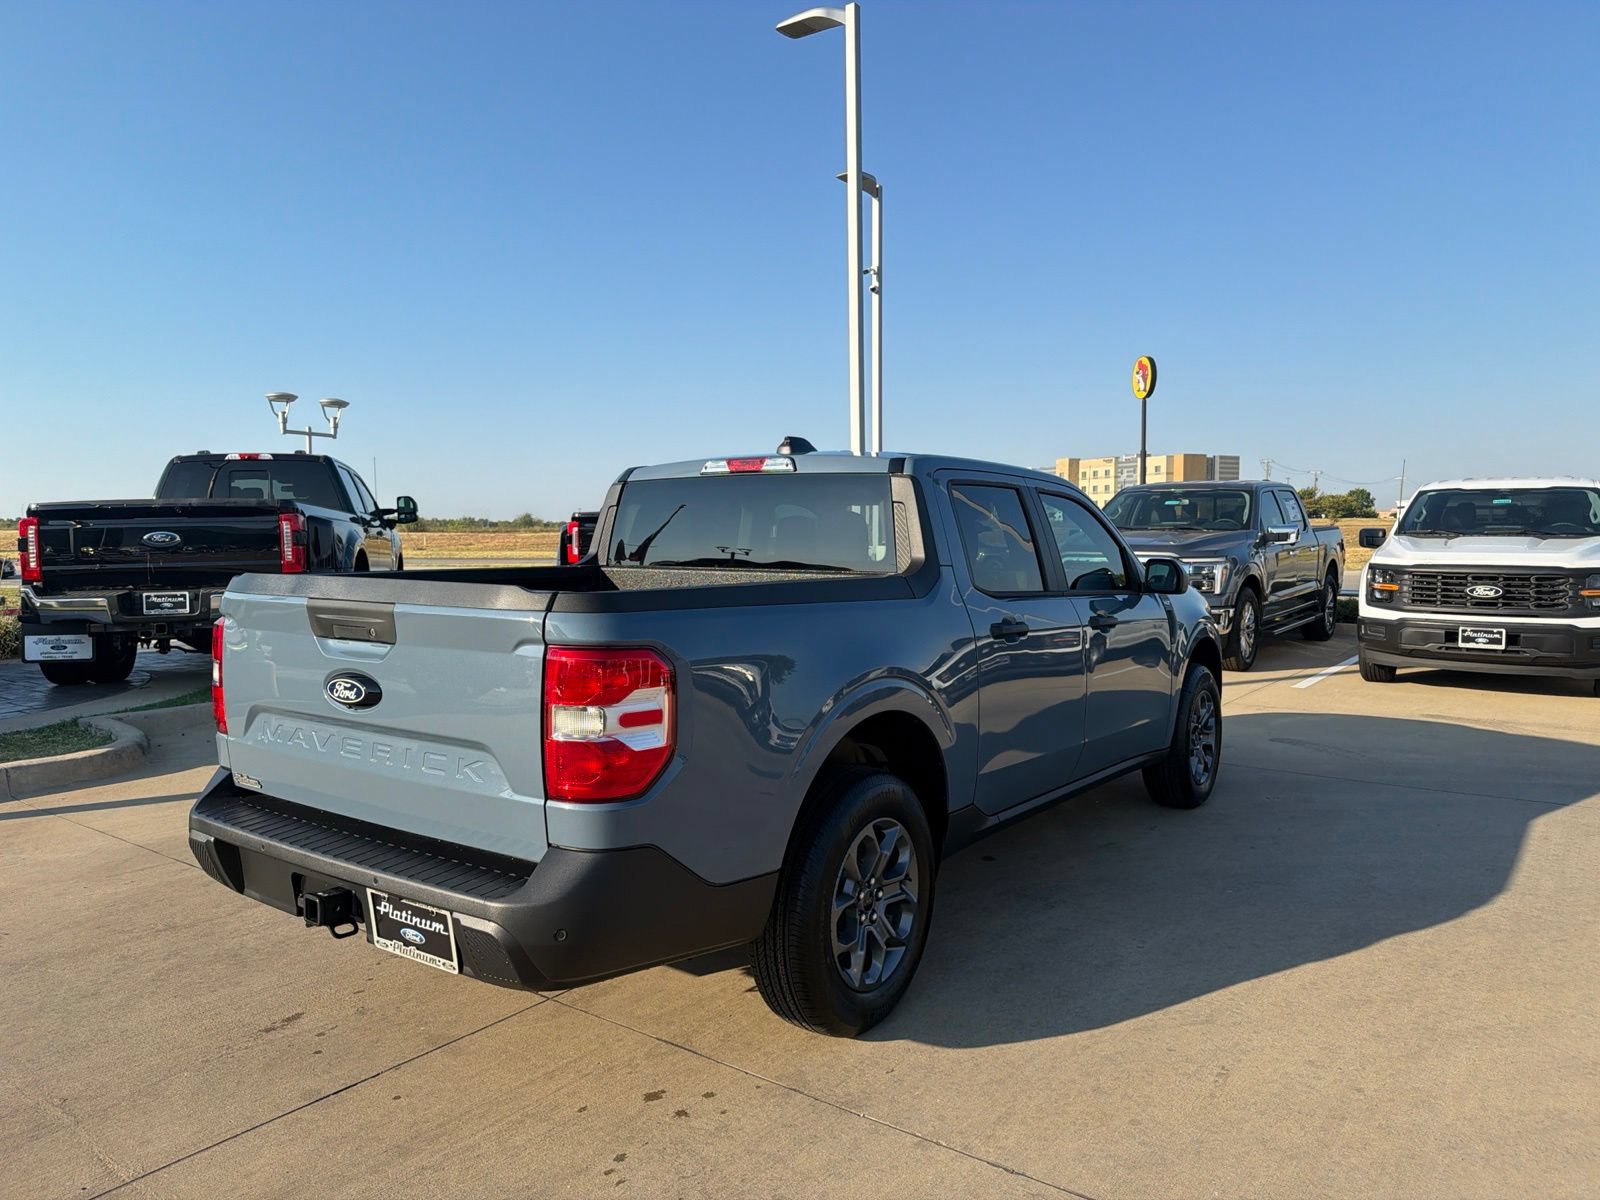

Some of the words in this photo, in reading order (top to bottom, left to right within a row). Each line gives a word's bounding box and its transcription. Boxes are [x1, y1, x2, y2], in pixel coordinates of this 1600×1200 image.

[1472, 586, 1497, 596] Ford
[1463, 631, 1502, 639] Platinum
[332, 681, 358, 700] Ford
[259, 720, 484, 783] MAVERICK
[376, 901, 449, 935] Platinum
[392, 942, 441, 967] Platinum
